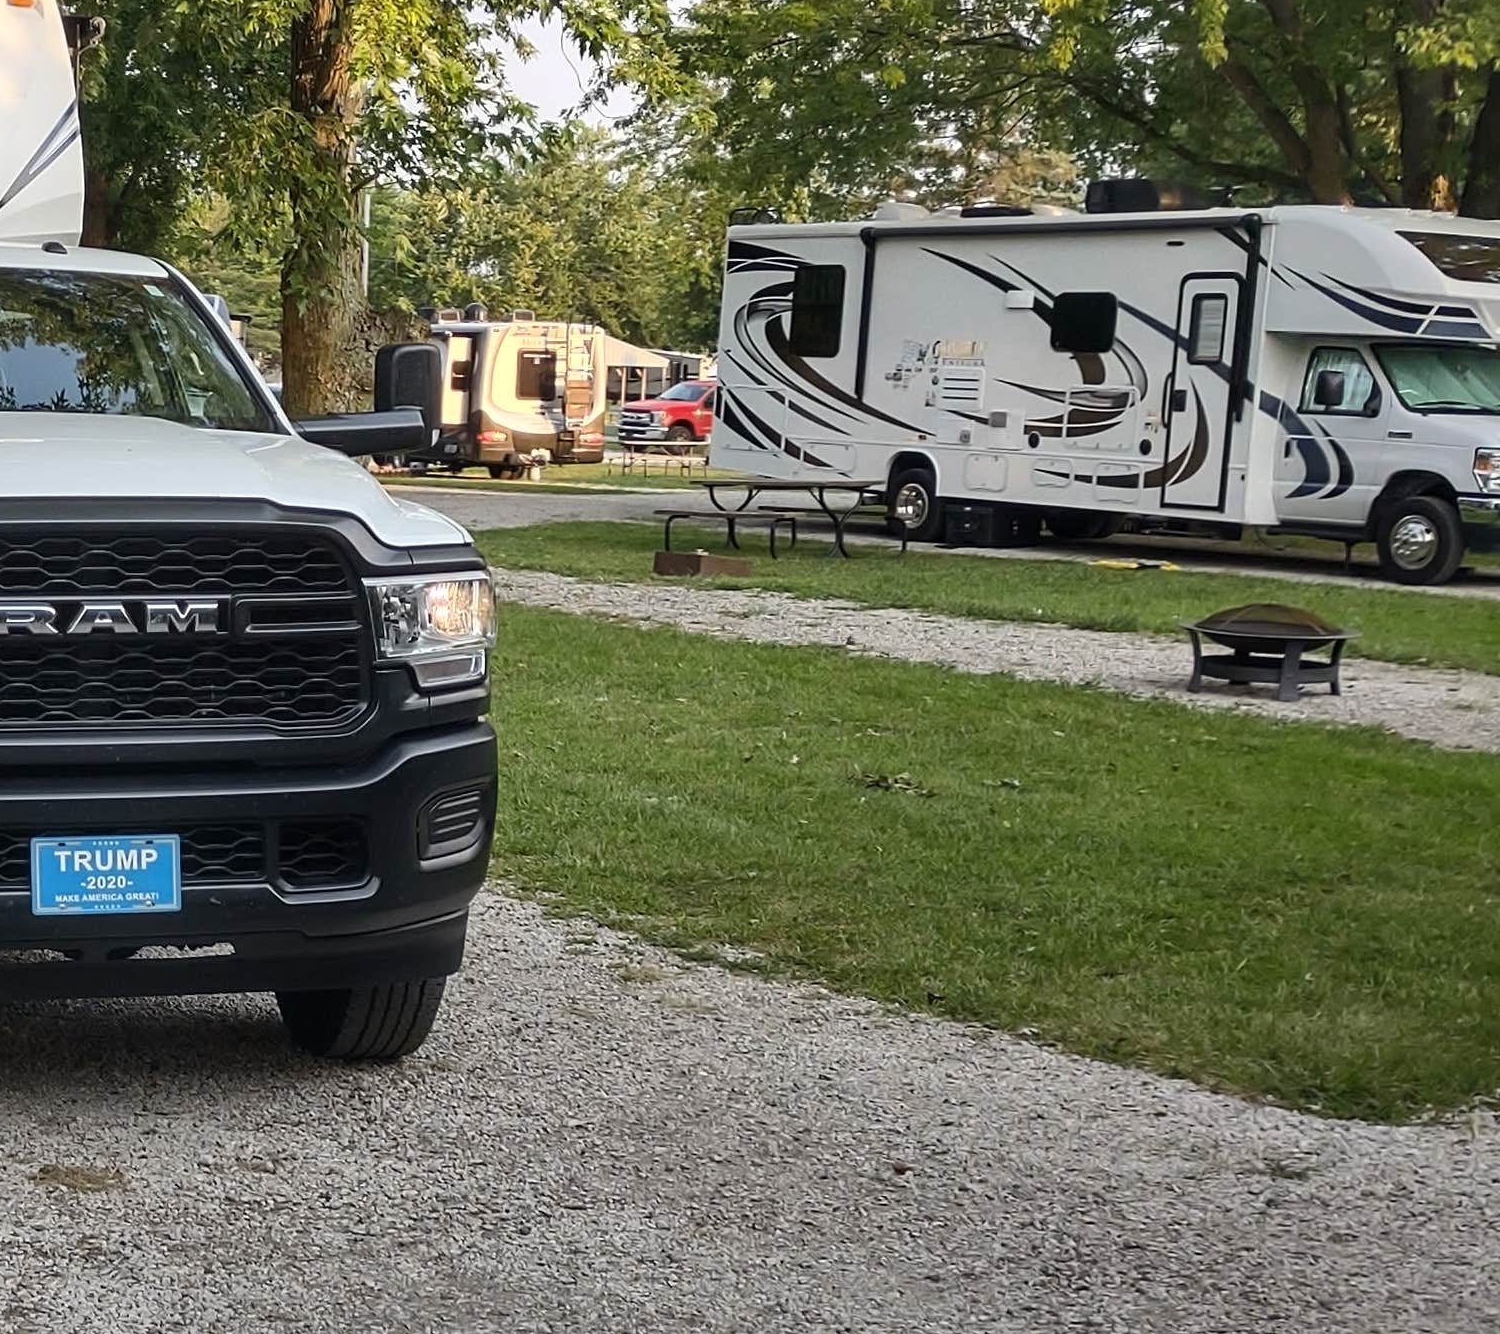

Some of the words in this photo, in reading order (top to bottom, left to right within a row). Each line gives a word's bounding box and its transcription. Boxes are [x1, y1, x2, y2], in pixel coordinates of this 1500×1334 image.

[54, 848, 158, 872] TRUMP
[55, 894, 80, 902] MAKE
[82, 893, 124, 902] AMERICA
[125, 892, 159, 901] GREAT!
